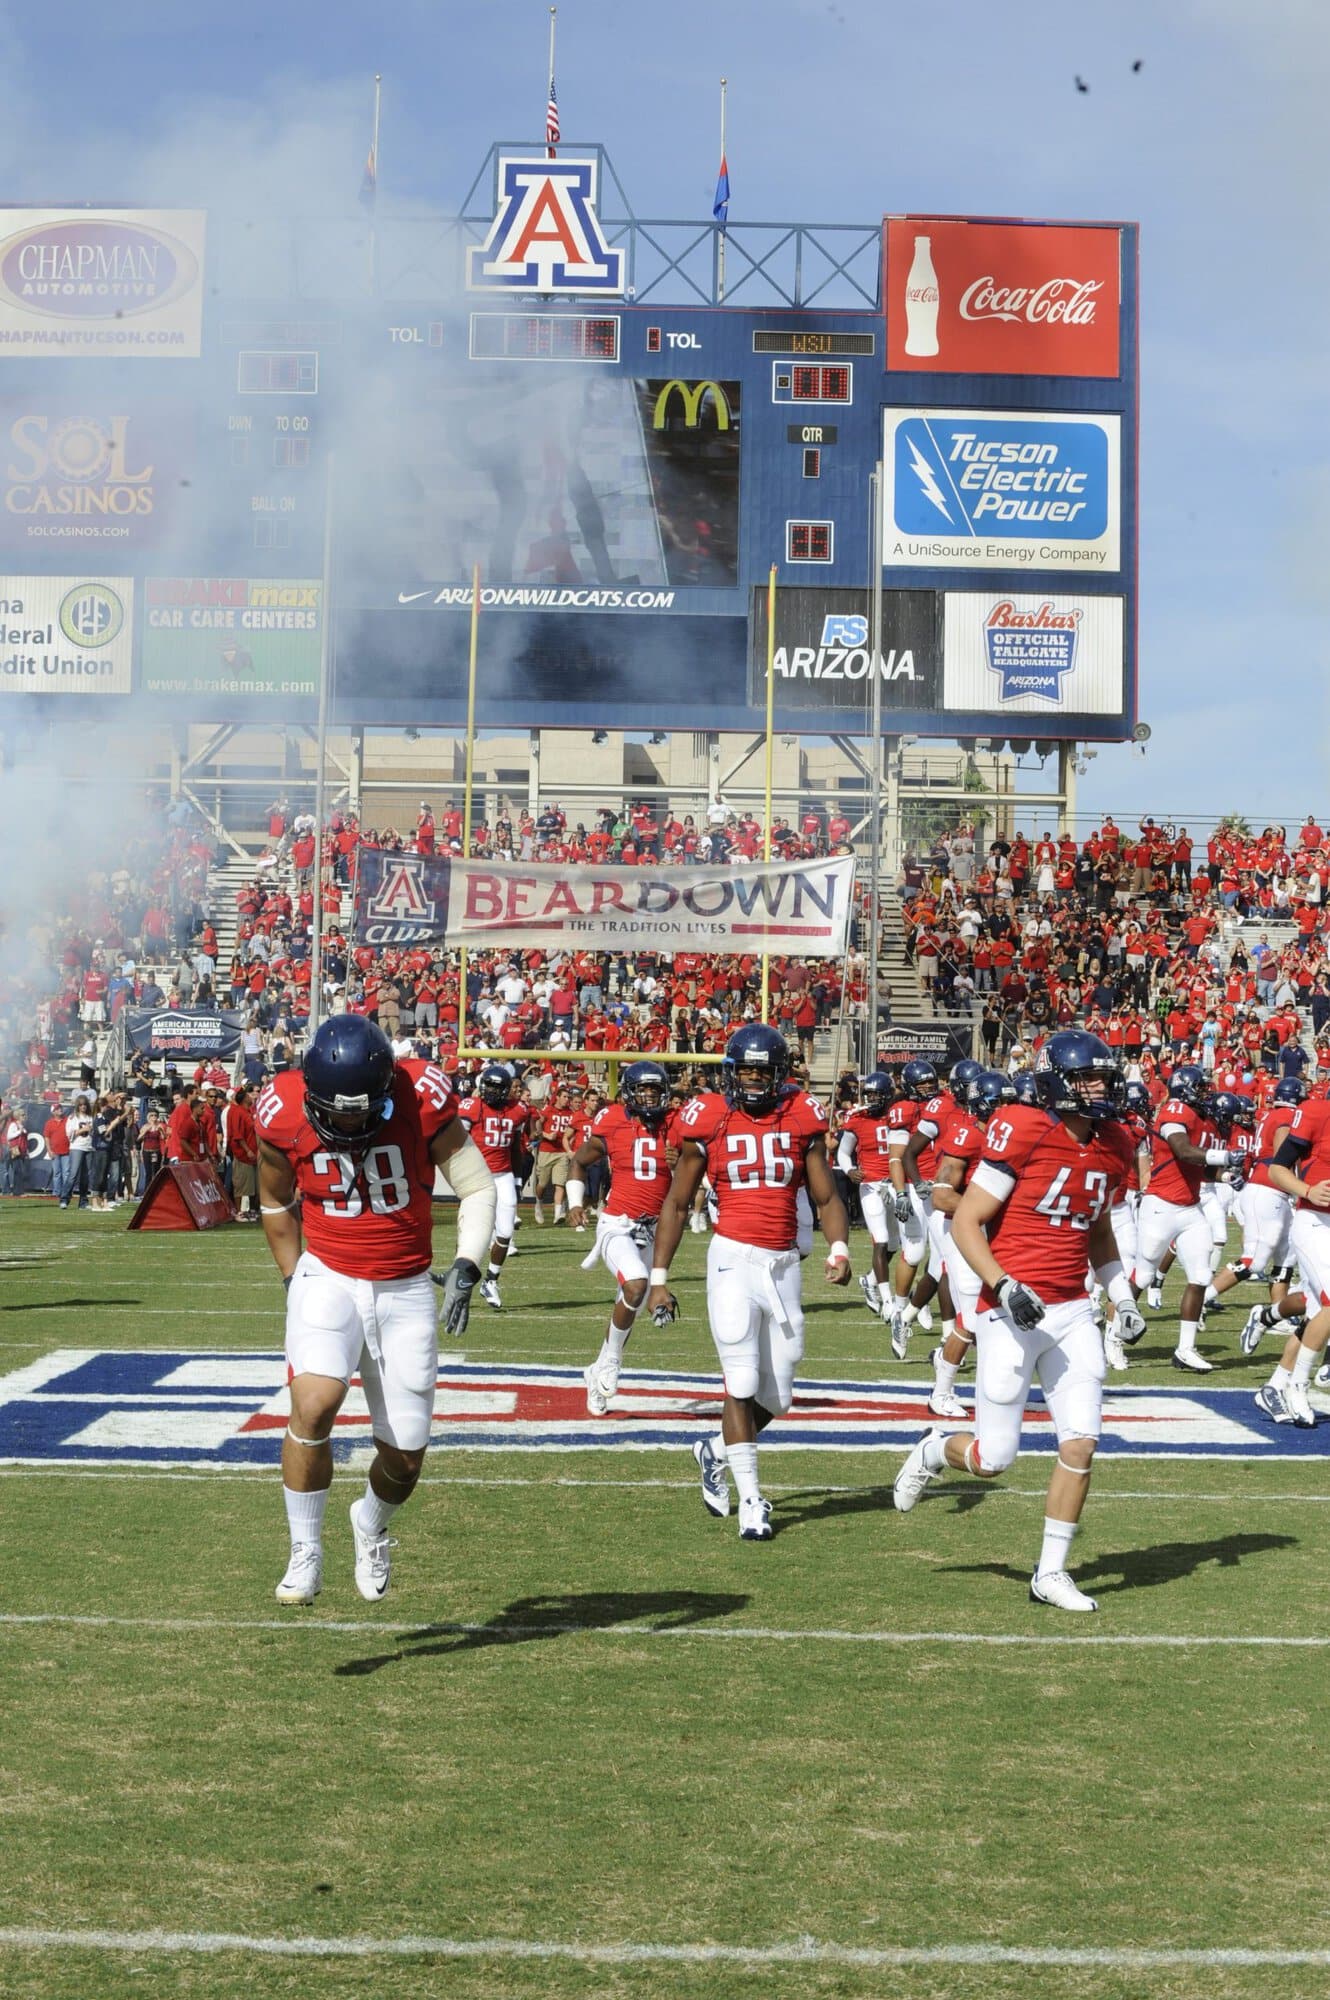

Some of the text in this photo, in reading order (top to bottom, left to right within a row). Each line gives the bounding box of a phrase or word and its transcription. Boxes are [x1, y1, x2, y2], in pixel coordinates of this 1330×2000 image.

[18, 245, 159, 280] CHAPMAN
[22, 283, 156, 296] AUTOMOTIVE
[960, 276, 1104, 324] Coca-Cola
[389, 327, 424, 342] TOL
[666, 333, 702, 348] TOL
[792, 334, 832, 353] WSU
[276, 416, 308, 431] TO GO
[802, 427, 823, 442] QTR
[950, 433, 1058, 464] Tucson
[959, 463, 1087, 493] Electric
[5, 486, 153, 514] CASINOS
[252, 497, 276, 511] BALL
[972, 492, 1087, 522] Power
[27, 526, 129, 537] SOLCASINOS.COM
[893, 543, 1106, 563] A UniSource Energy Company
[149, 610, 316, 629] CAR CARE CENTERS
[821, 614, 868, 647] FS
[993, 633, 1069, 645] OFFICIAL
[993, 646, 1068, 658] TAILGATE
[43, 655, 113, 674] Union
[765, 647, 915, 680] ARIZONA
[993, 659, 1067, 667] HEADQUARTERS
[147, 679, 314, 693] www.brakemax.com
[1006, 676, 1055, 685] ARIZONA
[365, 924, 434, 943] CLUB
[571, 920, 726, 934] THE TRADITION LIVES
[879, 1035, 918, 1043] AMERICAN
[1167, 1103, 1184, 1114] 41
[484, 1117, 514, 1148] 52
[986, 1118, 1014, 1152] 43
[633, 1136, 658, 1181] 6
[726, 1131, 795, 1191] 26
[312, 1145, 411, 1218] 38
[1033, 1166, 1108, 1231] 43
